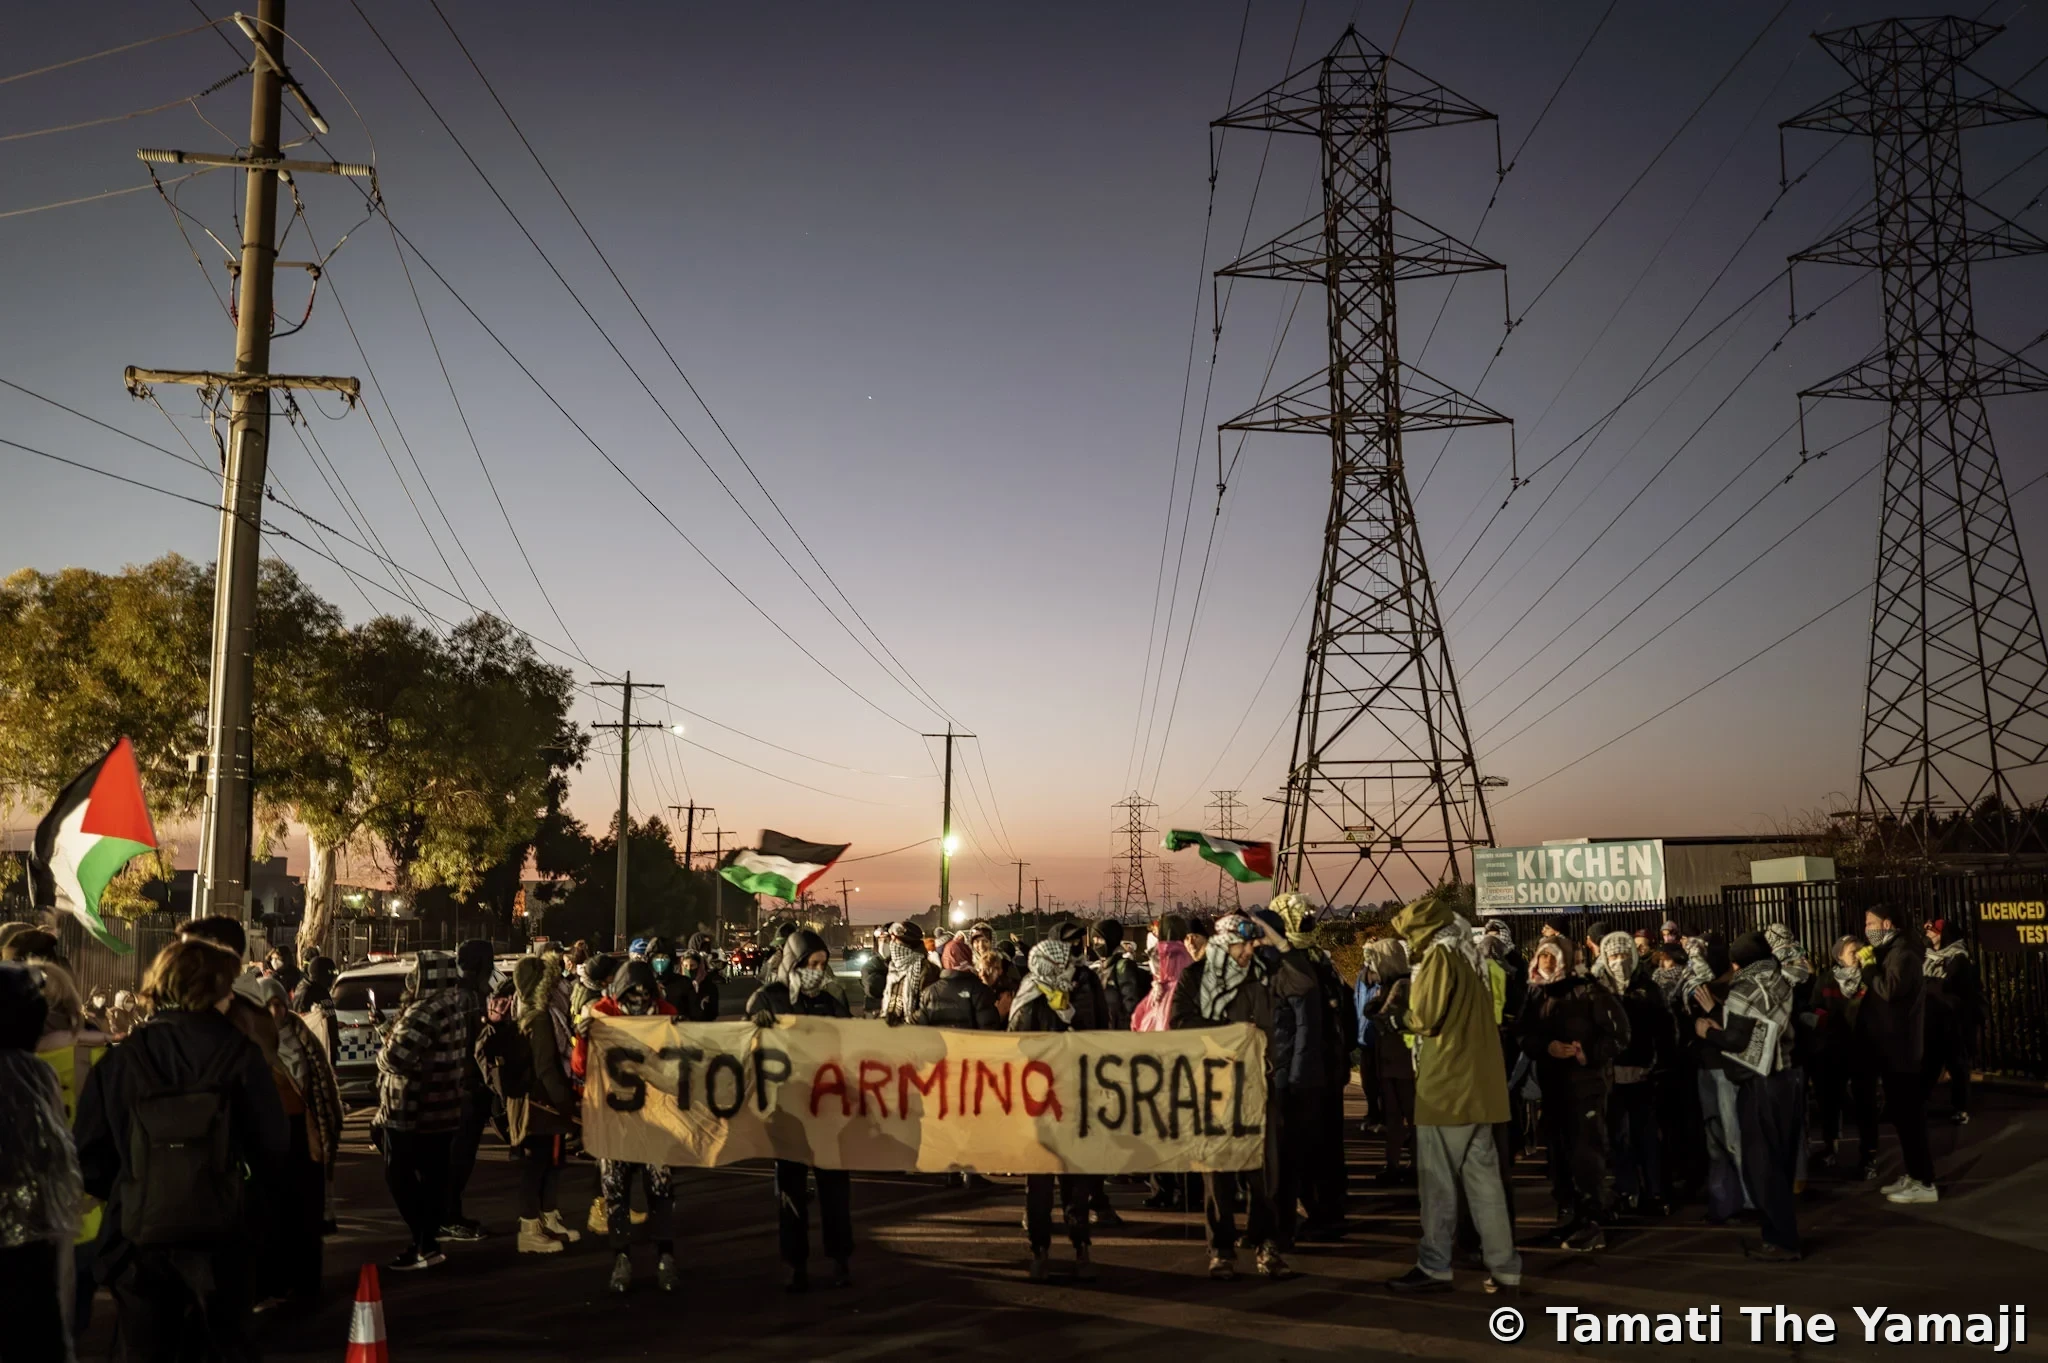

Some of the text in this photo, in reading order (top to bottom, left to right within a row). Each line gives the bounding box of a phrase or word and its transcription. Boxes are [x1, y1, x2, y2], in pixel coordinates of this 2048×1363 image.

[1516, 845, 1653, 880] KITCHEN
[1517, 879, 1655, 904] SHOWROOM
[1980, 901, 2046, 920] LICENCED
[606, 1046, 792, 1119] STOP
[1078, 1054, 1262, 1139] ISRAEL
